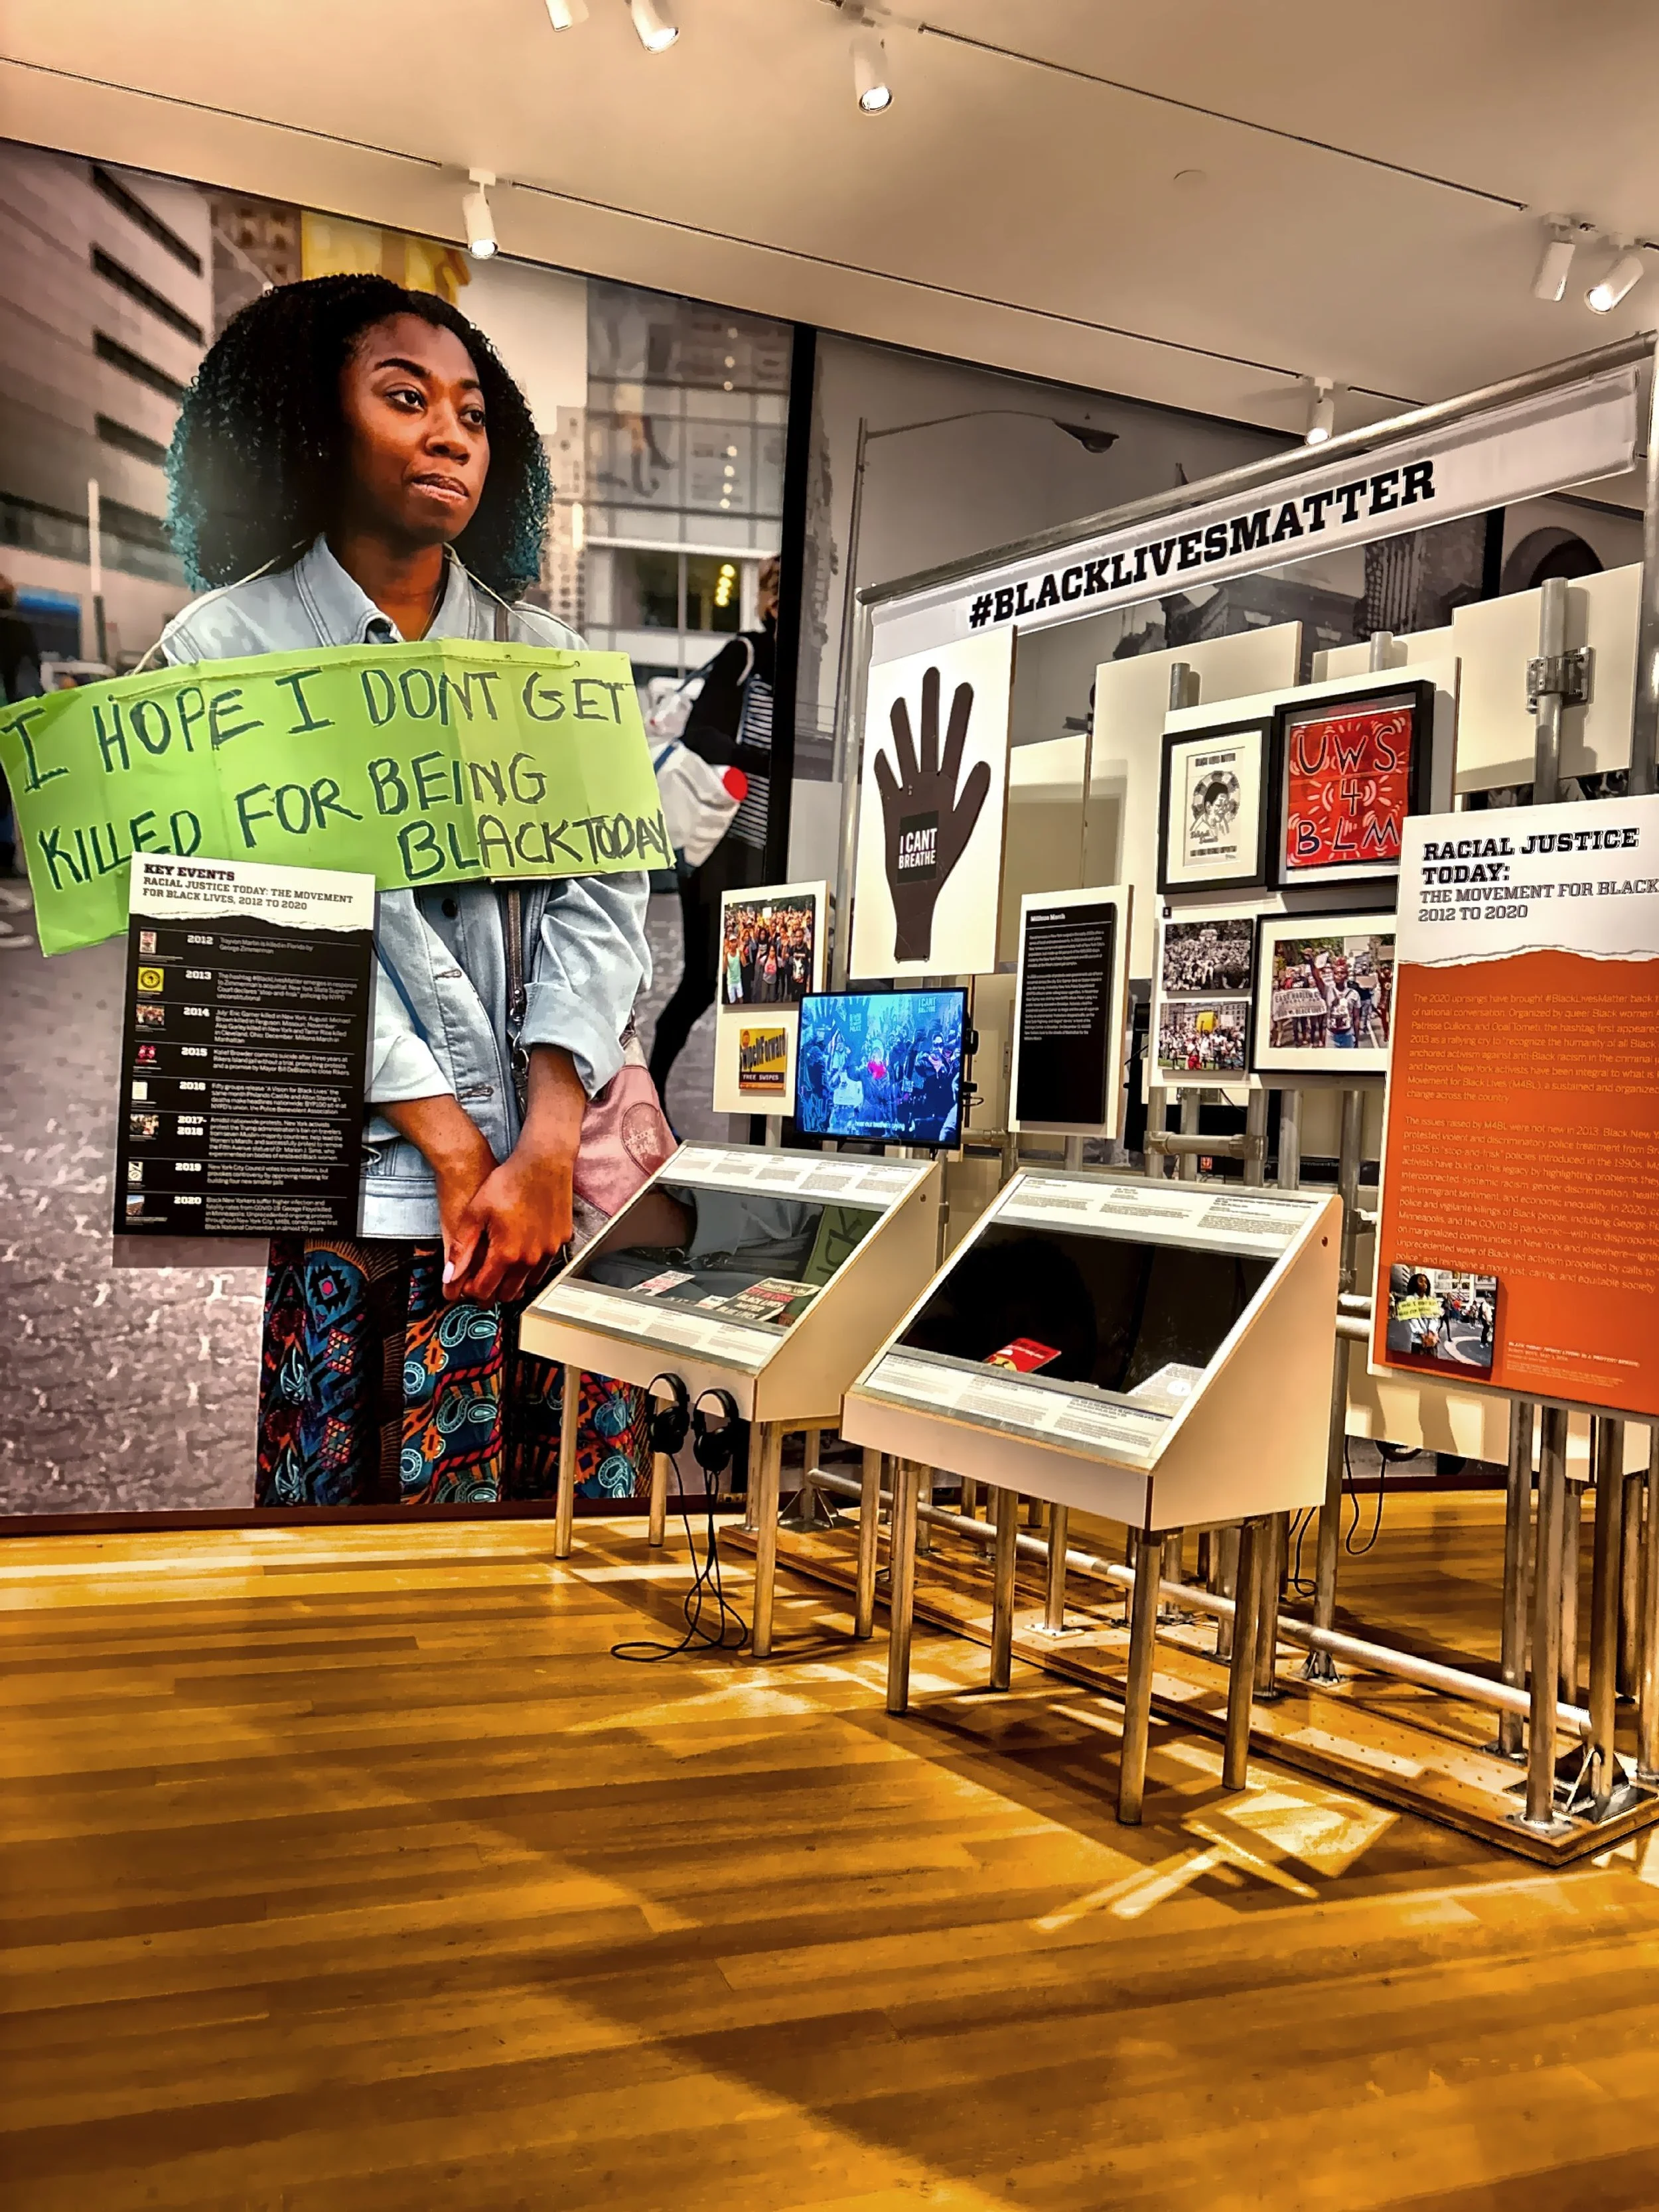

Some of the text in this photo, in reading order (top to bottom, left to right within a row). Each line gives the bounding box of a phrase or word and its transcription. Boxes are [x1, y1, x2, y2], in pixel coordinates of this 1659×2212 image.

[970, 460, 1436, 628] #BLACKLIVESMATTER
[3, 669, 636, 794] I HOPE I DONT GET
[1297, 726, 1396, 775] UWS
[1340, 778, 1362, 815] 4
[38, 750, 547, 890] KILLED FOR BEING
[397, 808, 671, 880] BLACK TODAY
[899, 828, 938, 854] I CANT
[1297, 816, 1401, 857] BLM
[1423, 828, 1640, 861] RACIAL JUSTICE
[898, 850, 936, 869] BREATHE
[144, 863, 235, 882] KEY EVENTS
[1421, 863, 1510, 885] TODAY:
[143, 877, 353, 904] RACIAL JUSTICE TODAY: THE MOVEMENT
[143, 888, 307, 910] FOR BLACK LIVES, 2012 TO 2020
[1420, 878, 1659, 904] THE MOVEMENT FOR BLACK
[1418, 904, 1528, 922] 2012 TO 2020
[186, 935, 214, 945] 2012
[185, 969, 212, 980] 2013
[1413, 994, 1428, 1002] The
[1429, 994, 1450, 1002] 2020
[1489, 994, 1508, 1002] have
[1510, 995, 1543, 1004] brought
[1546, 995, 1628, 1003] #BlackLivesMatter
[1630, 994, 1653, 1003] back
[183, 1006, 210, 1017] 2014
[1508, 1008, 1551, 1019] Organized
[1553, 1009, 1562, 1019] by
[1593, 1009, 1618, 1018] Black
[1560, 1023, 1595, 1034] hashtag
[1597, 1023, 1615, 1032] first
[1410, 1035, 1429, 1044] 2013
[1478, 1038, 1491, 1047] cry
[1493, 1036, 1501, 1044] to
[1548, 1038, 1561, 1046] the
[1563, 1038, 1606, 1048] humanity
[1607, 1038, 1617, 1047] of
[1618, 1039, 1628, 1048] all
[1630, 1039, 1656, 1048] Black
[181, 1047, 208, 1057] 2015
[1409, 1049, 1446, 1058] anchored
[1447, 1050, 1480, 1058] activism
[1482, 1051, 1512, 1061] against
[1557, 1053, 1587, 1062] racism
[1457, 1064, 1474, 1072] New
[1475, 1064, 1493, 1073] York
[1494, 1065, 1529, 1074] activists
[1530, 1066, 1550, 1075] have
[1553, 1067, 1573, 1075] been
[1575, 1068, 1609, 1079] integral
[1611, 1069, 1620, 1077] to
[1622, 1070, 1645, 1078] what
[1647, 1070, 1655, 1079] is
[179, 1081, 206, 1091] 2016
[1407, 1076, 1448, 1085] Movement
[1450, 1077, 1461, 1085] for
[1463, 1077, 1484, 1087] Black
[1486, 1079, 1507, 1087] Lives
[1551, 1082, 1595, 1091] sustained
[1596, 1083, 1614, 1092] and
[1406, 1090, 1435, 1100] change
[177, 1115, 207, 1125] 2017-
[1406, 1116, 1419, 1125] The
[1473, 1120, 1482, 1131] by
[1531, 1125, 1546, 1133] not
[1548, 1125, 1564, 1135] new
[1567, 1127, 1575, 1135] in
[1603, 1127, 1628, 1137] Black
[1630, 1129, 1651, 1139] New
[173, 1196, 202, 1205] 2020
[1486, 1264, 1508, 1273] more
[1559, 1273, 1577, 1283] and
[1578, 1275, 1619, 1286] equitable
